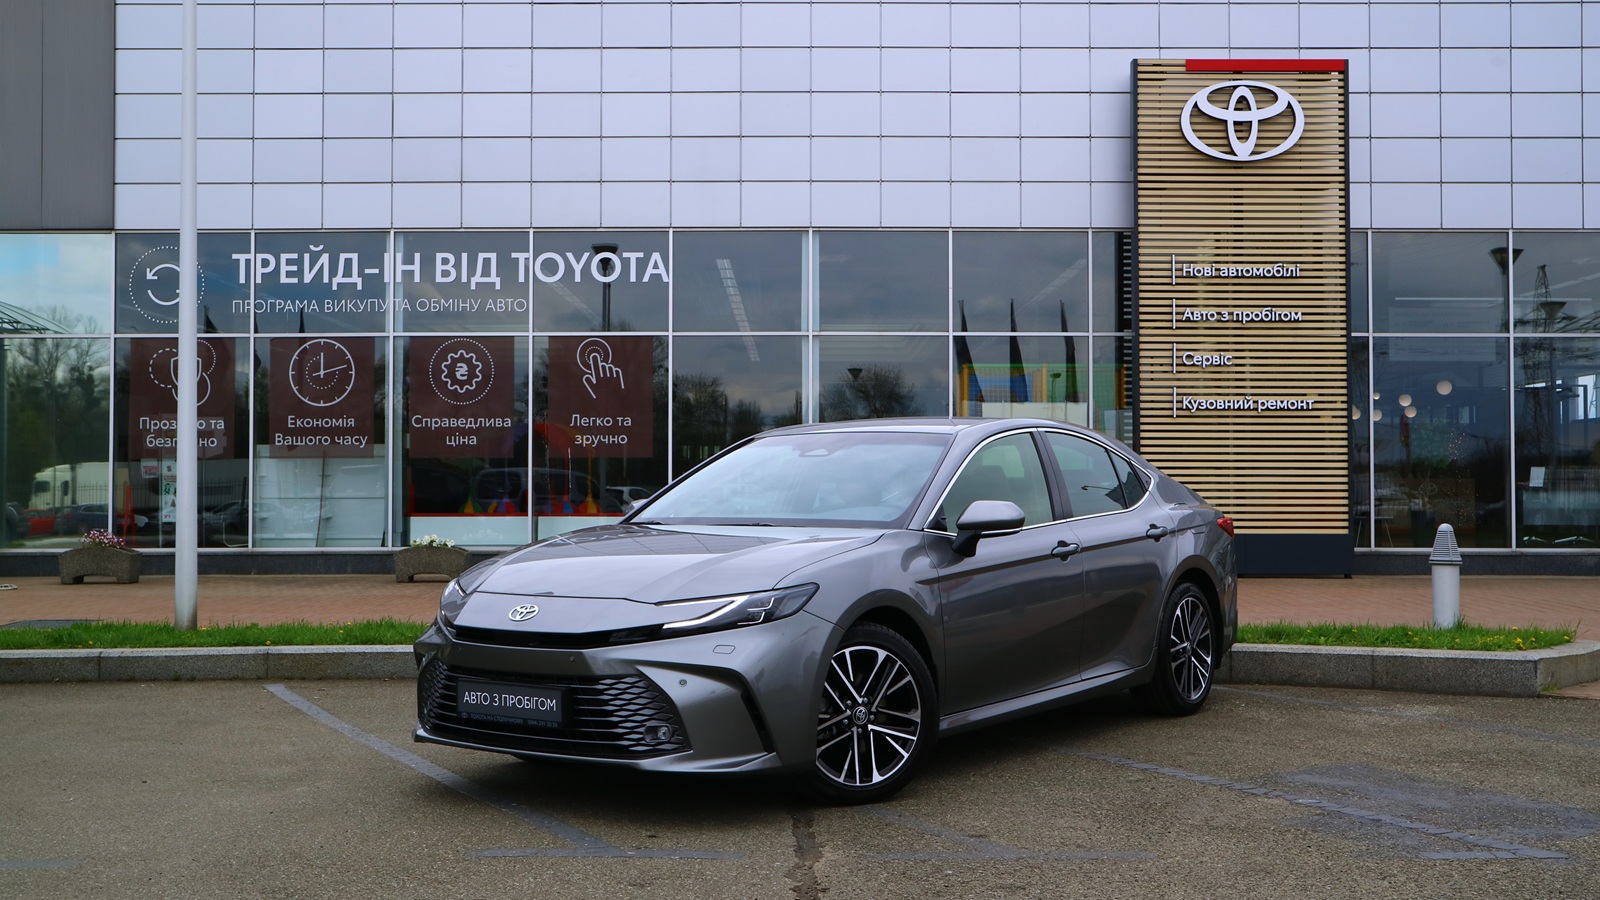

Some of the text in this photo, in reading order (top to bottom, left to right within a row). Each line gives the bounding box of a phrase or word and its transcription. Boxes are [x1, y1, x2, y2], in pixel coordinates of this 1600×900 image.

[231, 244, 669, 290] ТРЕЙД-ІН ВІД TOYOTA
[1182, 263, 1300, 277] Нові автомобілі
[232, 298, 527, 313] ПРОГРАМА ВИКУПУ ТА ОБМІНУ АВТО
[1182, 307, 1303, 325] Авто з пробігом
[1182, 352, 1233, 369] Сервіс
[1182, 395, 1315, 413] Кузовний ремонт
[139, 416, 225, 433] Прозо та
[287, 414, 355, 428] Економія
[411, 414, 512, 431] Справедлива
[569, 414, 632, 427] Легко та
[146, 434, 218, 448] безпно
[275, 432, 368, 449] Вашого часу
[446, 432, 477, 447] ціна
[574, 434, 628, 448] зручно
[463, 691, 557, 711] АВТО З ПРОБІГОМ
